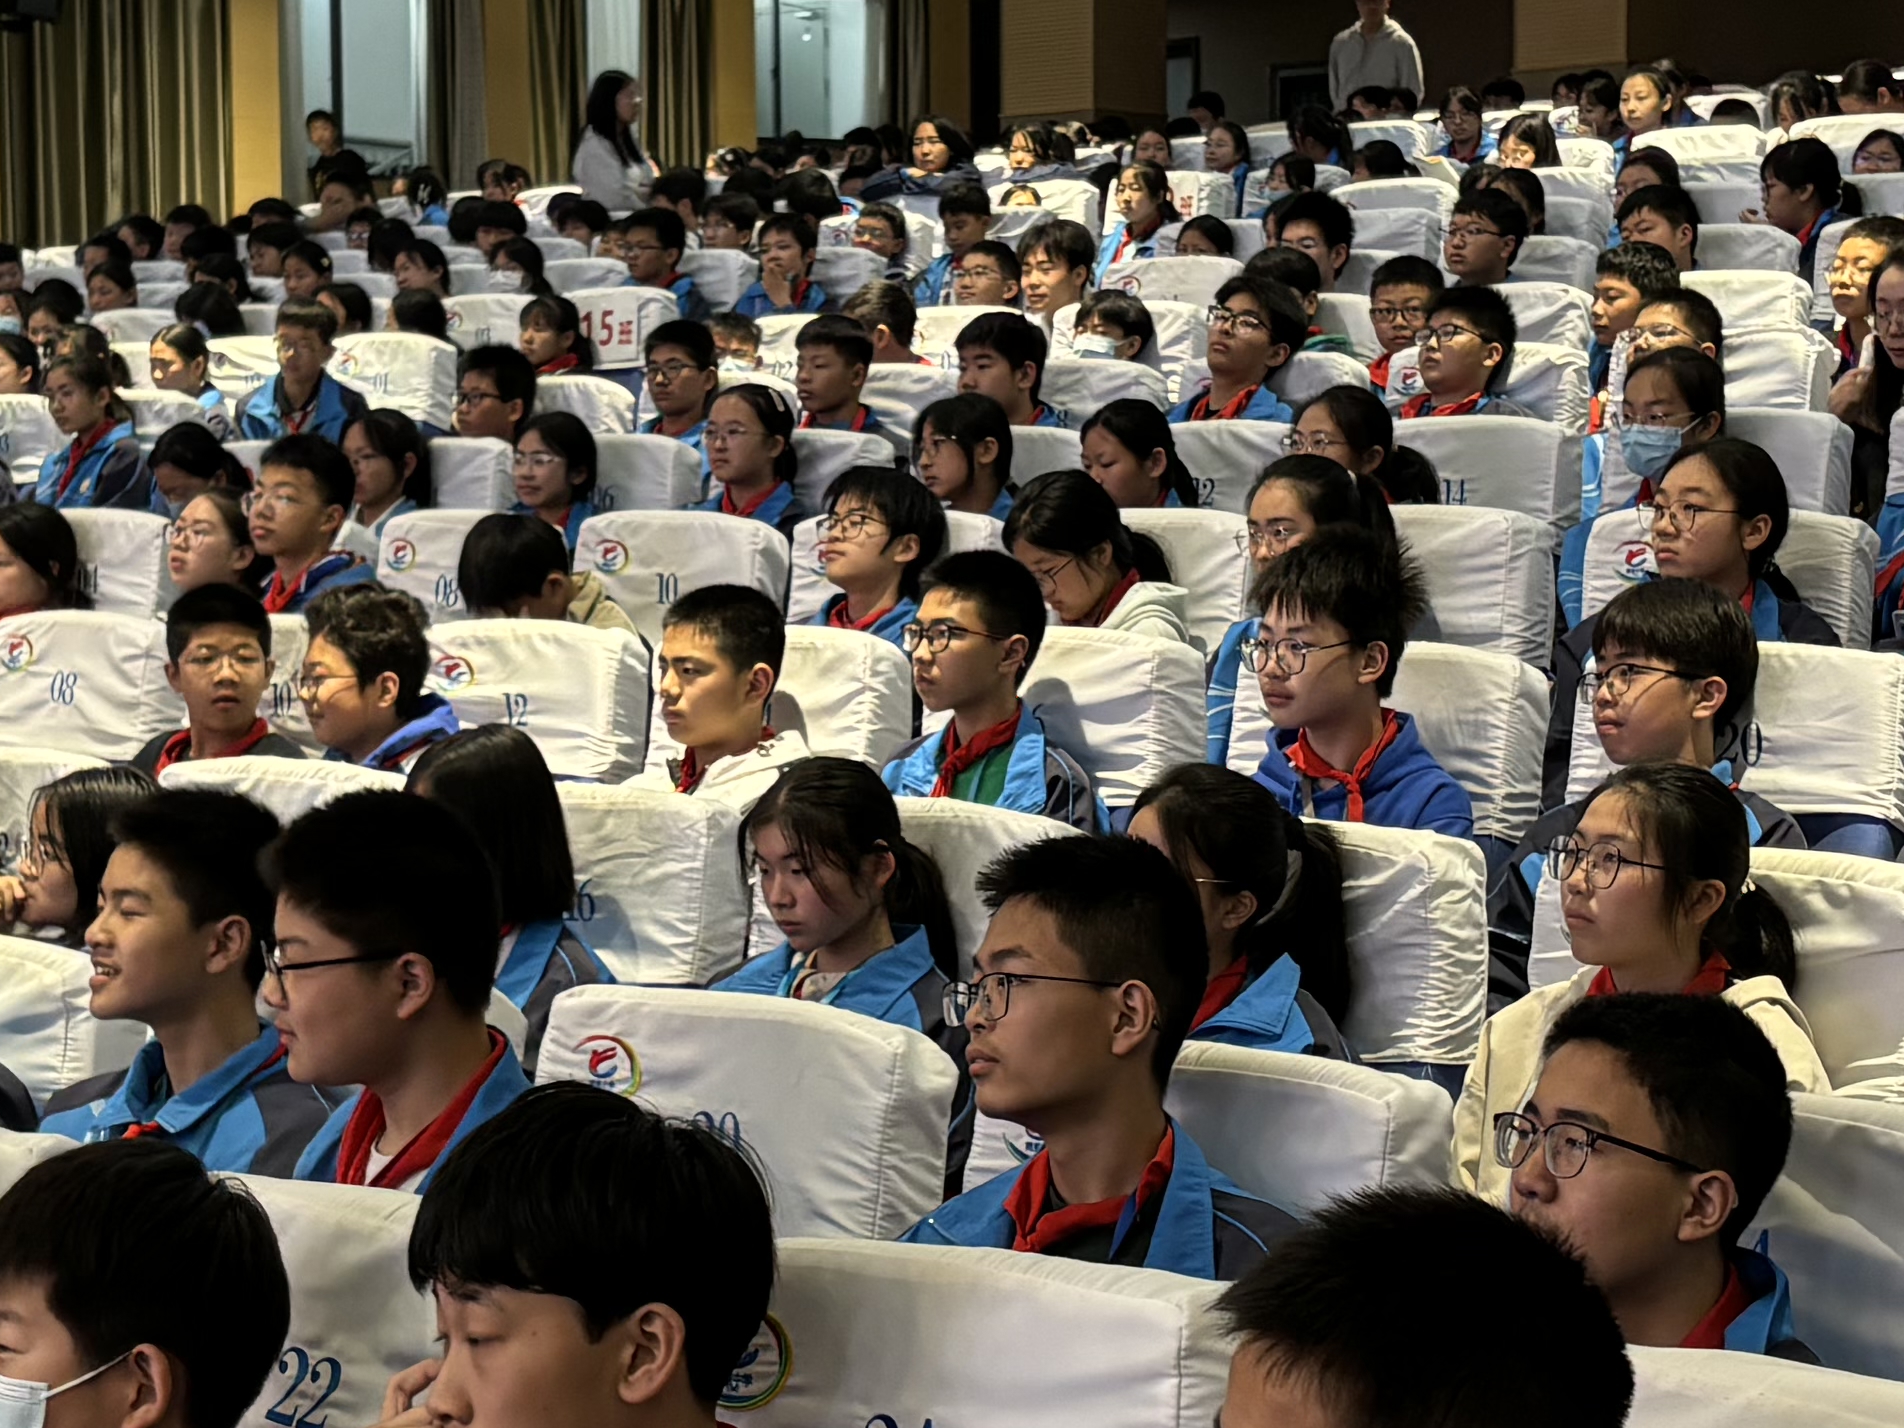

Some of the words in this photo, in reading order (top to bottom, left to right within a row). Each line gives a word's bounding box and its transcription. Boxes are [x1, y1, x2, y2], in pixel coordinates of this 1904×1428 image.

[1443, 479, 1468, 506] 14
[435, 573, 460, 608] 08
[656, 573, 679, 605] 10
[51, 670, 77, 706] 08
[272, 680, 292, 717] 10
[503, 692, 528, 727] 12
[1716, 721, 1763, 767] 20
